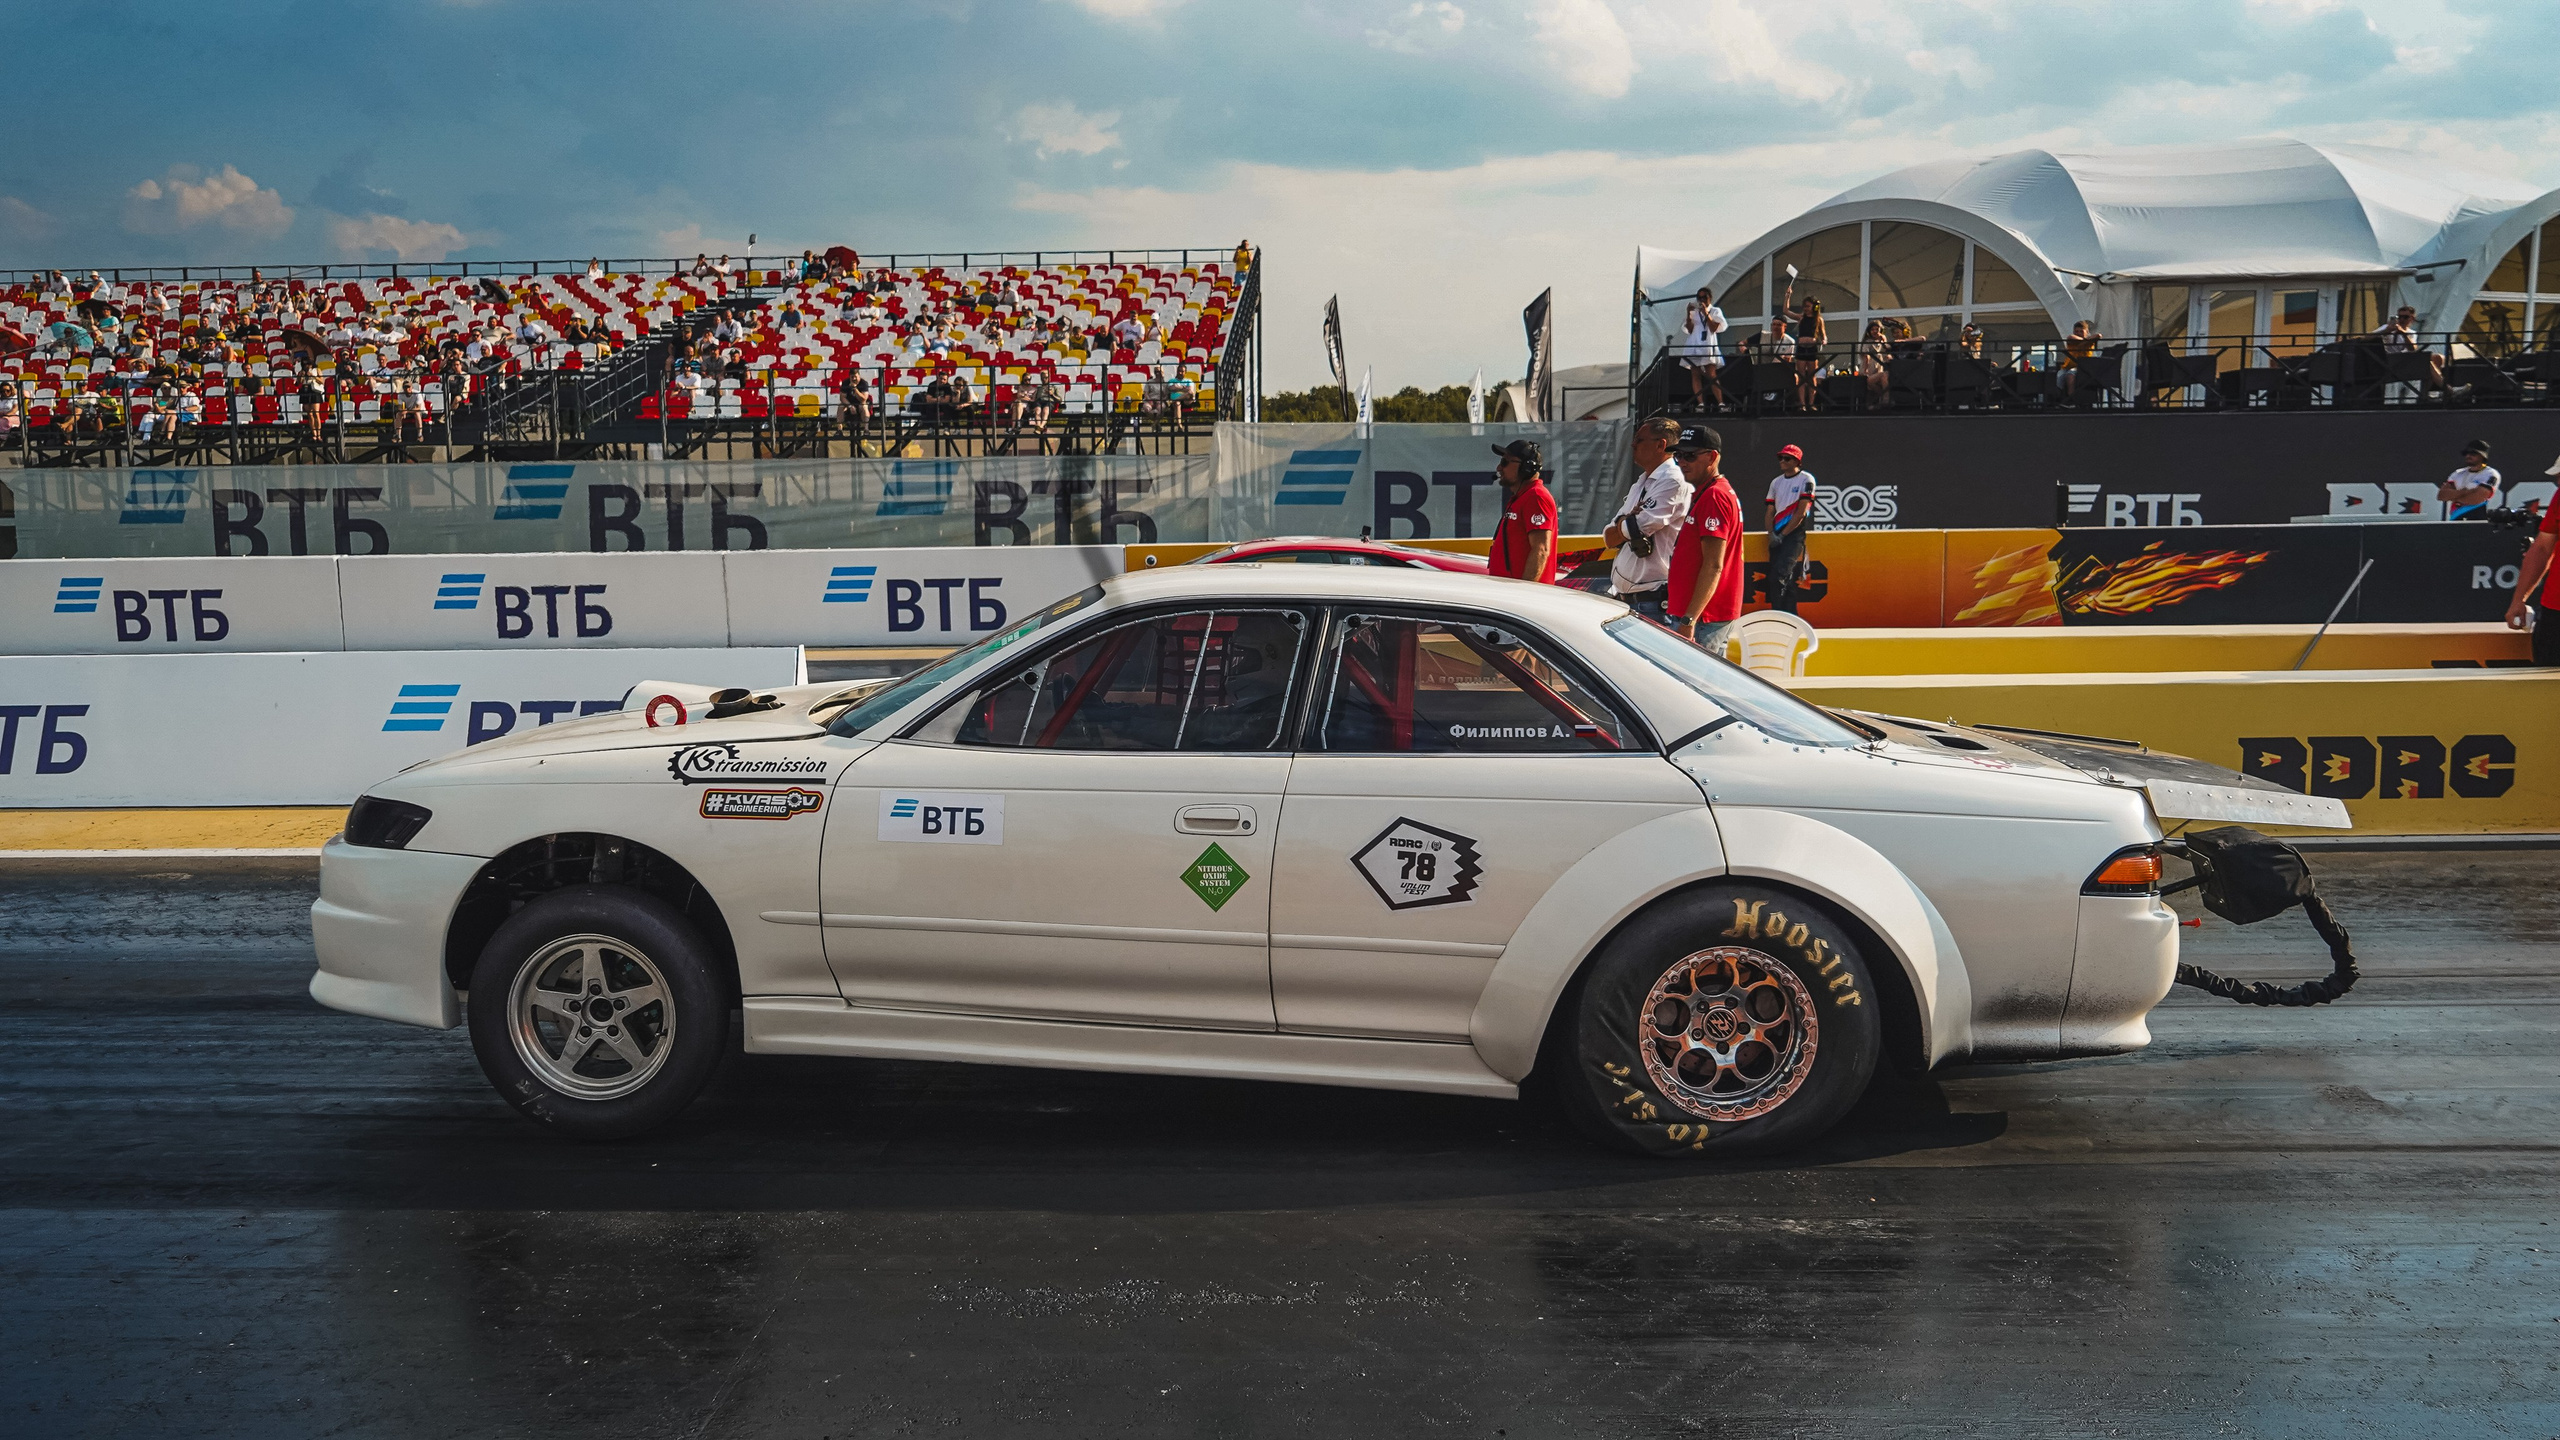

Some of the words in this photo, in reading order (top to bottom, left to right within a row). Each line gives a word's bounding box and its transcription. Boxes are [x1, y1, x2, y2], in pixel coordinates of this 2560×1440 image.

[588, 483, 768, 552] ВТБ
[974, 479, 1158, 546] ВТБ
[1814, 485, 1898, 522] ROS
[2106, 493, 2202, 527] ВТБ
[212, 487, 390, 556] ВТБ
[113, 589, 229, 642] ВТБ
[494, 584, 613, 639] ВТБ
[886, 578, 1007, 632] ВТБ
[1450, 723, 1547, 738] Филиппов
[1552, 724, 1570, 738] А.
[2238, 734, 2516, 799] RDRC
[723, 804, 787, 813] ENGINEERING
[922, 805, 985, 836] ВТБ
[1389, 837, 1423, 849] RDRC
[1197, 865, 1233, 873] NITROUS
[1199, 879, 1231, 887] SYSTEM
[1202, 872, 1228, 880] OXIDE
[1397, 850, 1436, 882] 78
[1403, 888, 1427, 896] FEST
[1721, 897, 1862, 1008] Hoosier
